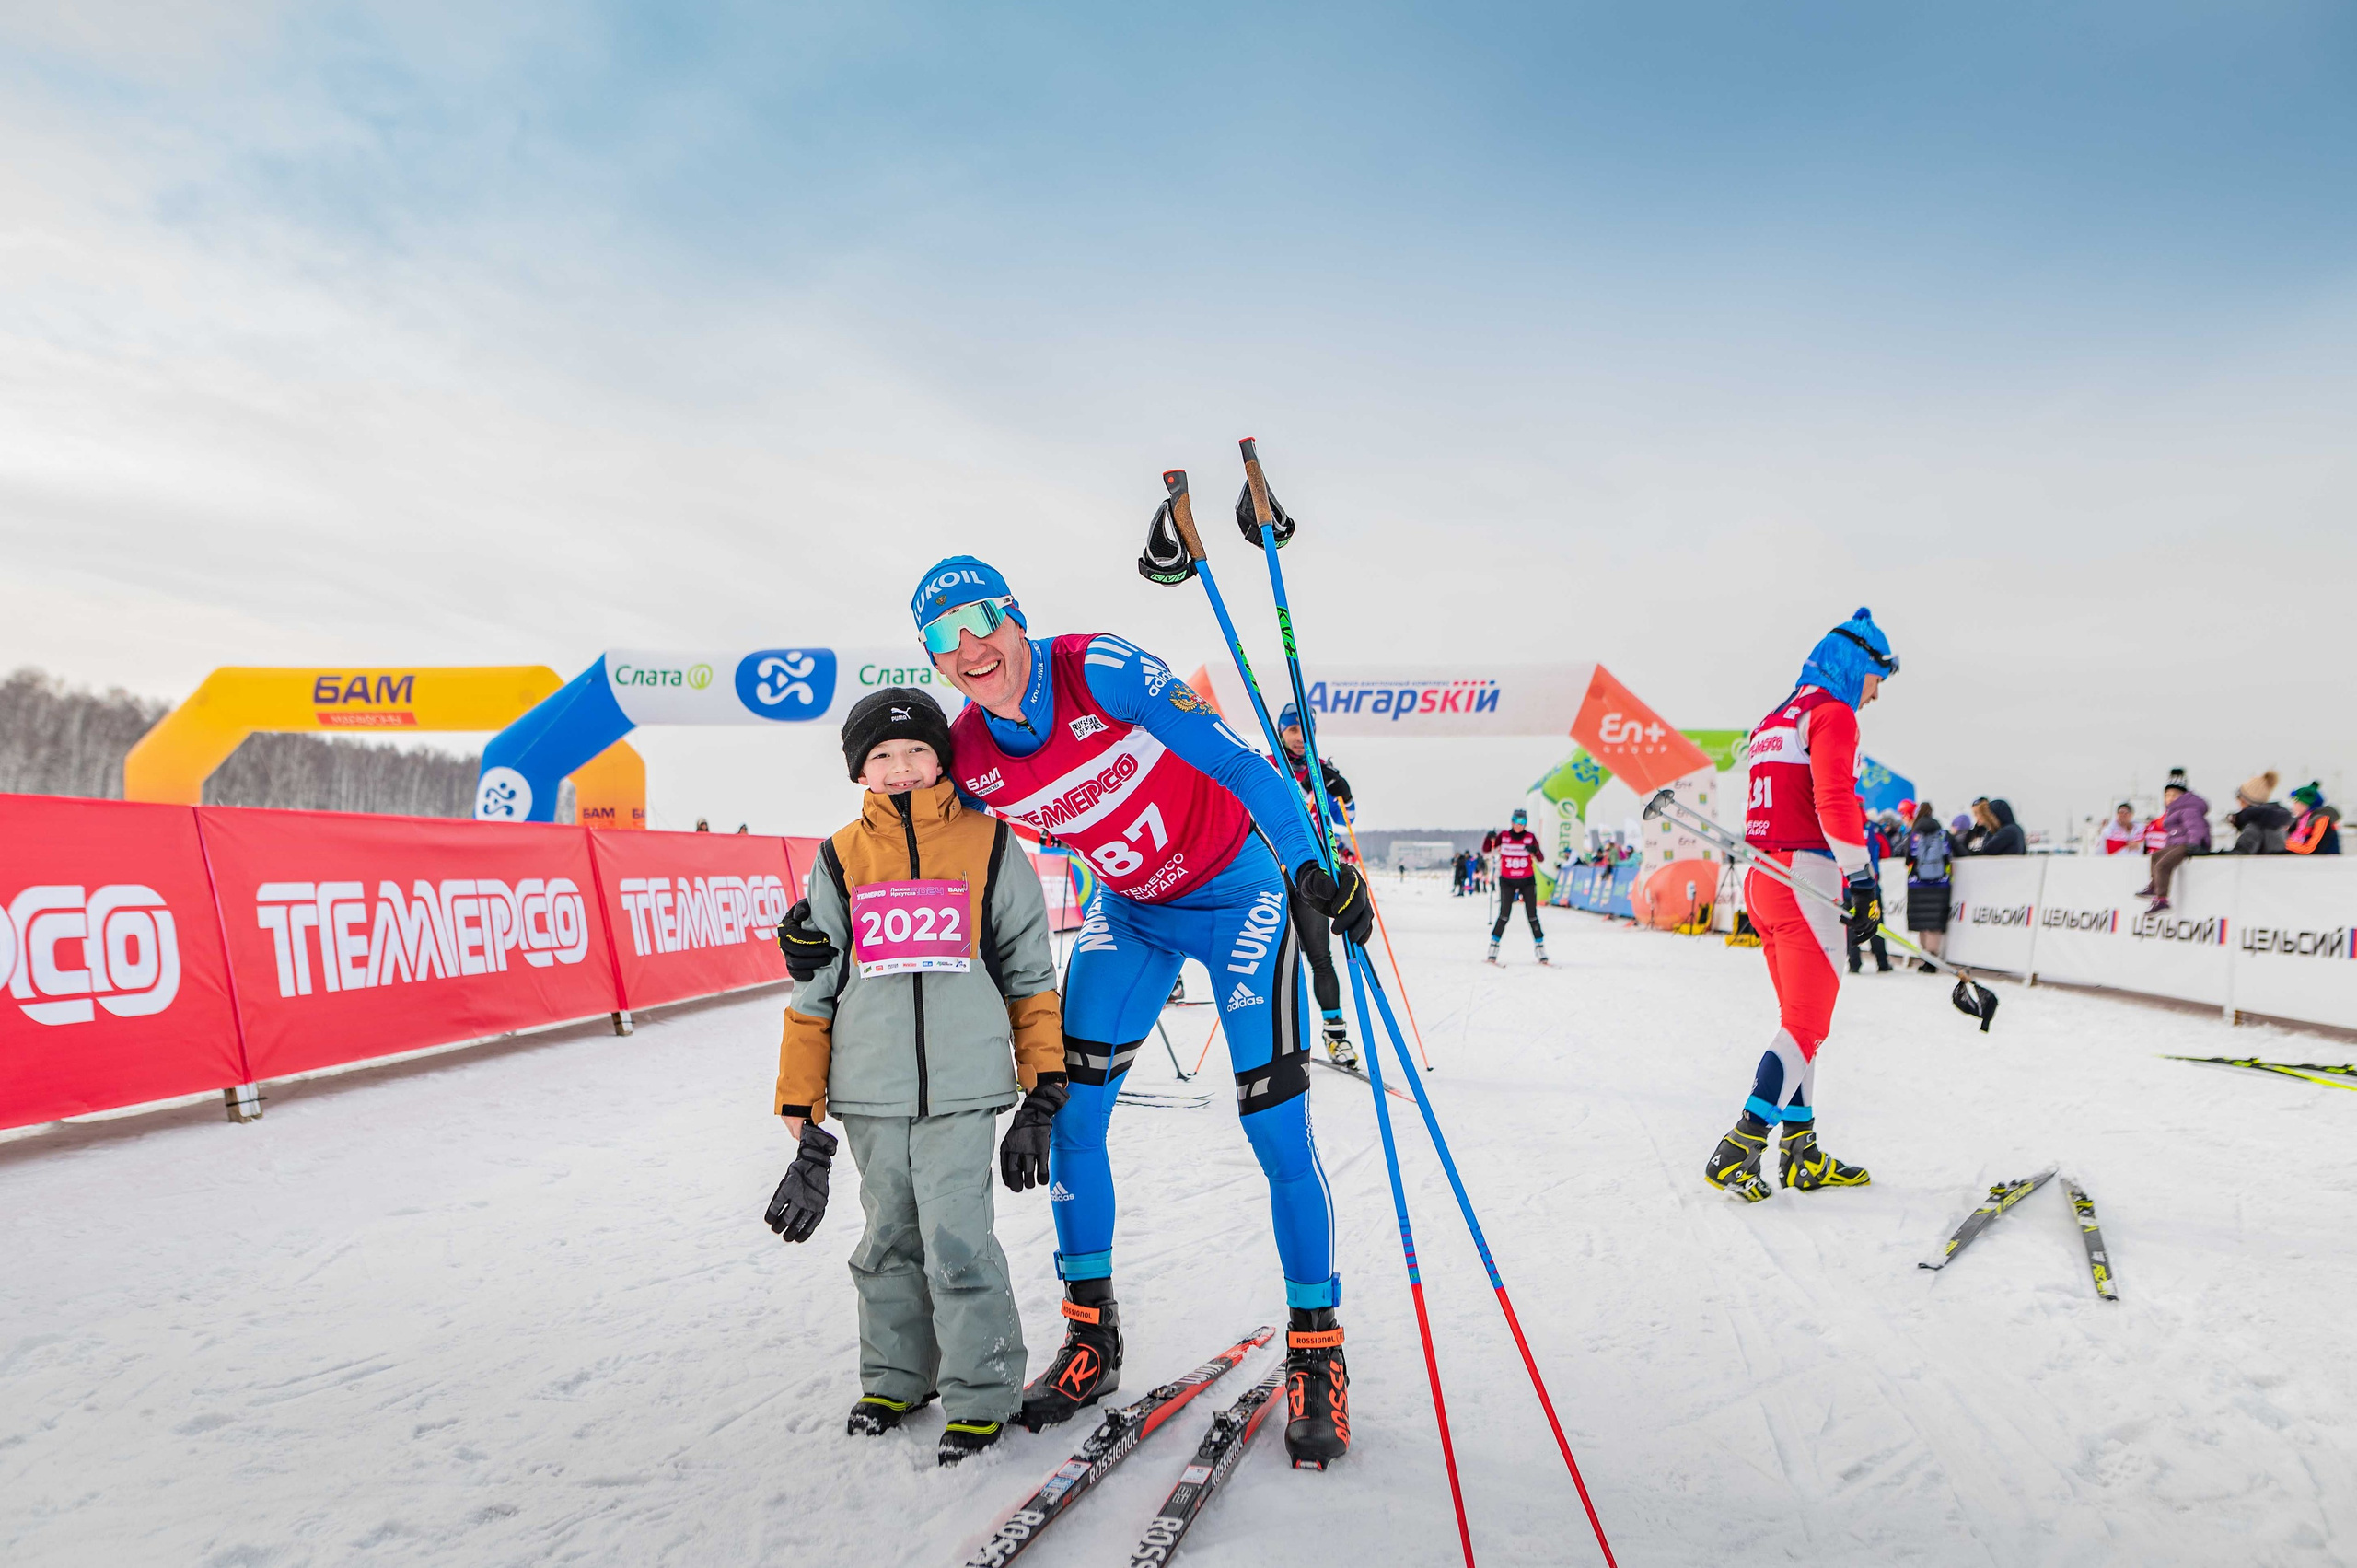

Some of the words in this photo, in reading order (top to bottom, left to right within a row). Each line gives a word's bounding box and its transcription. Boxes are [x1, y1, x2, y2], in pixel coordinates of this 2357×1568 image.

[1277, 605, 1296, 660] KV+
[314, 675, 415, 704] БАМ
[615, 663, 682, 687] Слата
[859, 664, 932, 687] Слата
[890, 714, 907, 723] PUMA
[1599, 713, 1666, 744] En+
[966, 767, 1001, 791] БАМ
[1306, 743, 1328, 815] TORNADO
[1074, 802, 1168, 878] 87
[1120, 853, 1184, 897] ТЕМЕРСО
[620, 876, 789, 957] ТЕМЕРСО
[860, 907, 962, 947] 2022
[1227, 891, 1283, 975] LUKOIL
[2131, 915, 2215, 945] ЦЕЛЬСИЙ
[0, 885, 181, 1026] СО
[256, 877, 589, 998] ТЕМЕРСО
[2241, 926, 2345, 959] ЦЕЛЬСИЙ
[1227, 996, 1265, 1013] adidas
[1296, 1334, 1335, 1344] ROSSIGNOL
[1089, 1428, 1138, 1484] ROSSIGNOL
[1212, 1432, 1244, 1489] ROSSIGNOL
